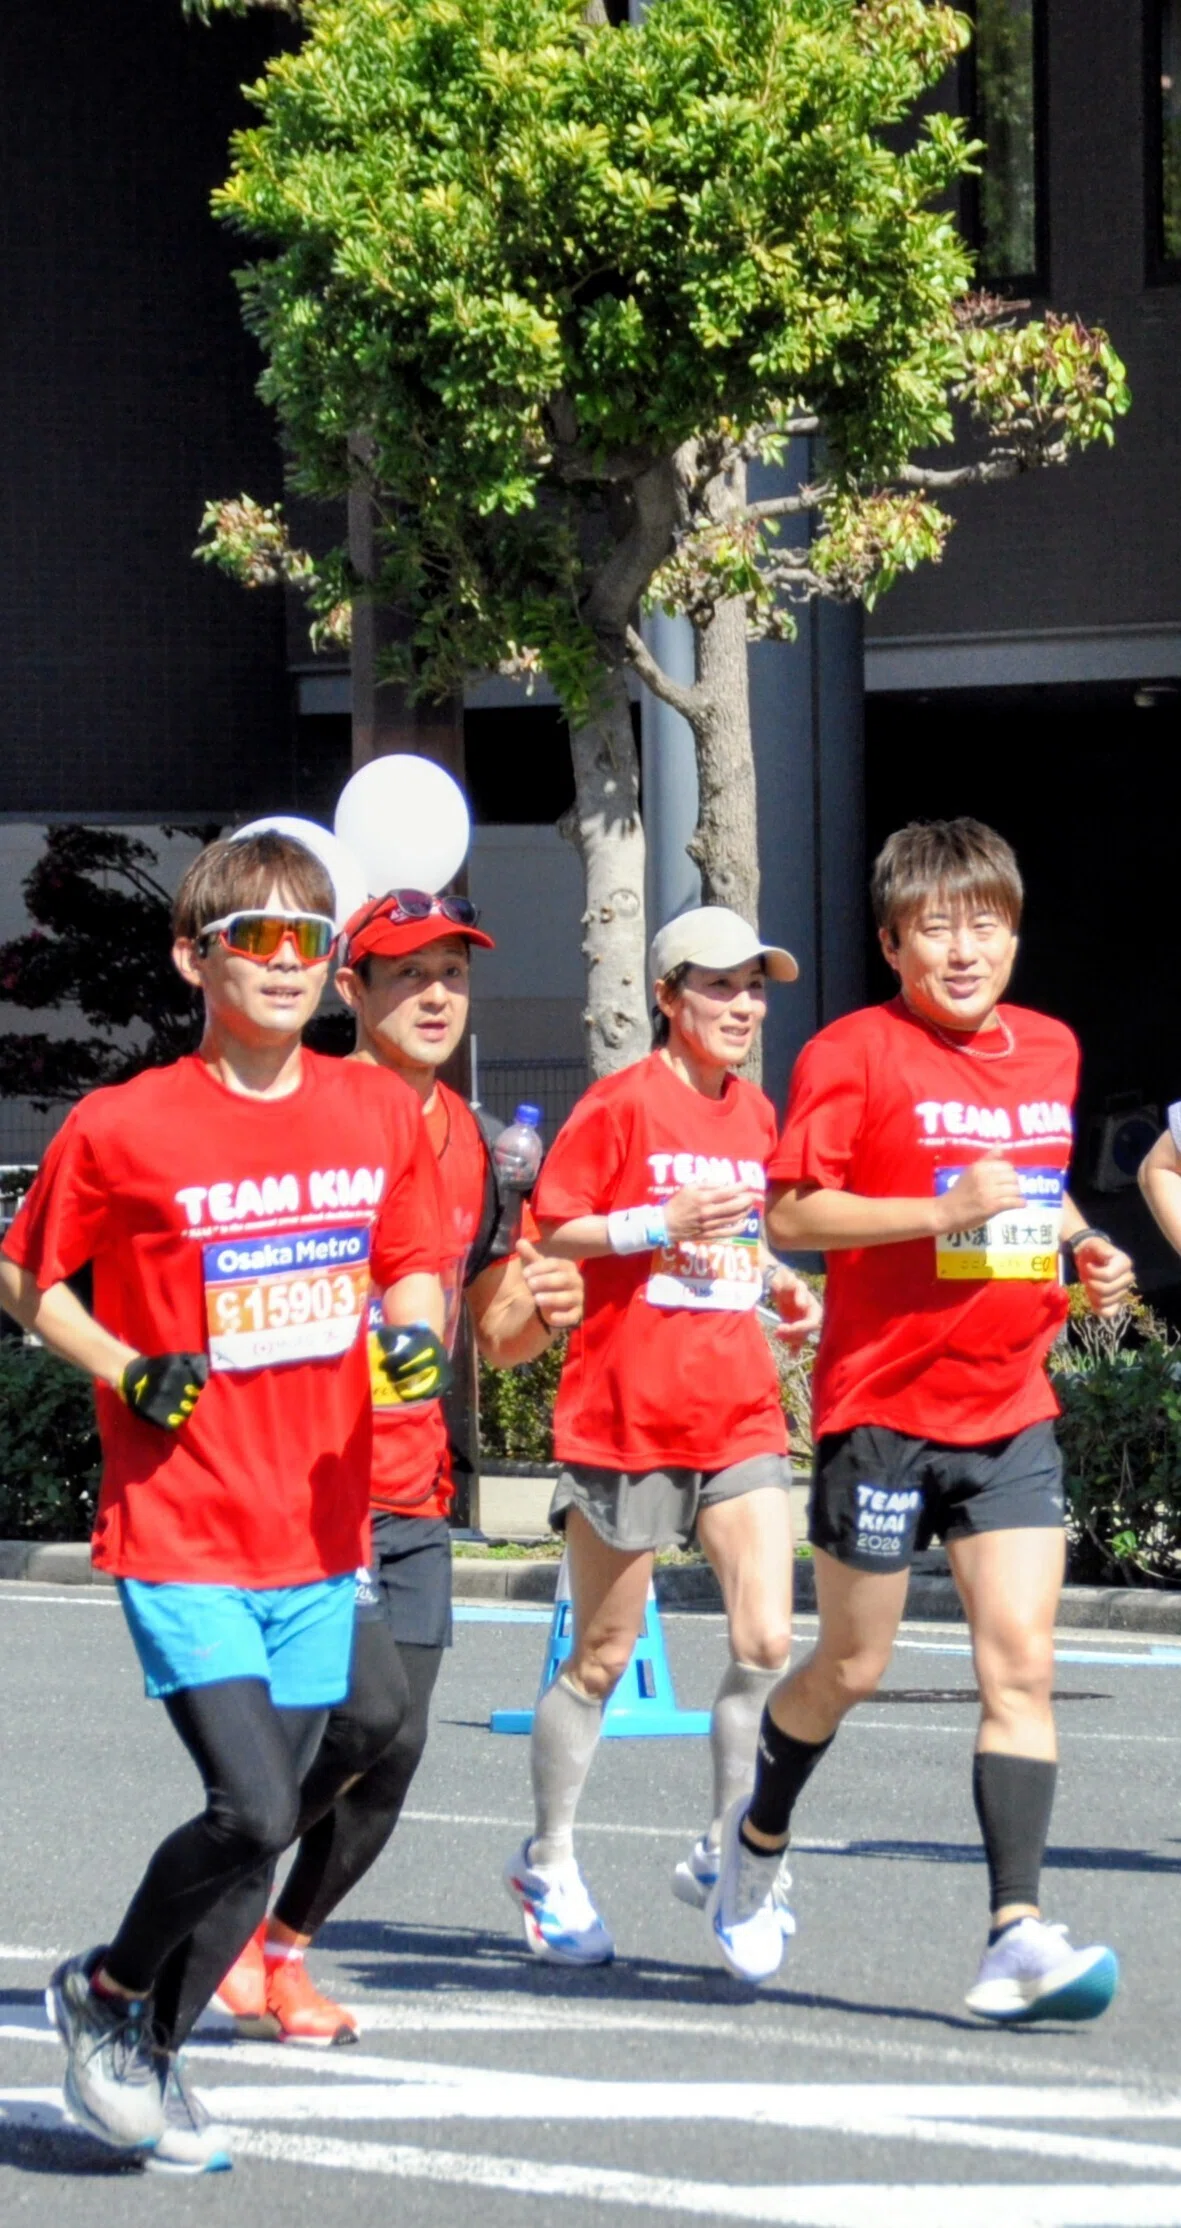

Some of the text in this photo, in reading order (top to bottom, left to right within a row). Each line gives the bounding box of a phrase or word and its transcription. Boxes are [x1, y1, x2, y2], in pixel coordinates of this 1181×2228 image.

[915, 1101, 1012, 1139] TEAM
[648, 1153, 736, 1185] TEAM
[175, 1174, 299, 1226] TEAM
[217, 1236, 360, 1273] Osaka Metro
[244, 1274, 355, 1331] 15903
[857, 1485, 920, 1512] TEAM
[858, 1510, 906, 1534] KIAI
[857, 1532, 901, 1550] 2026
